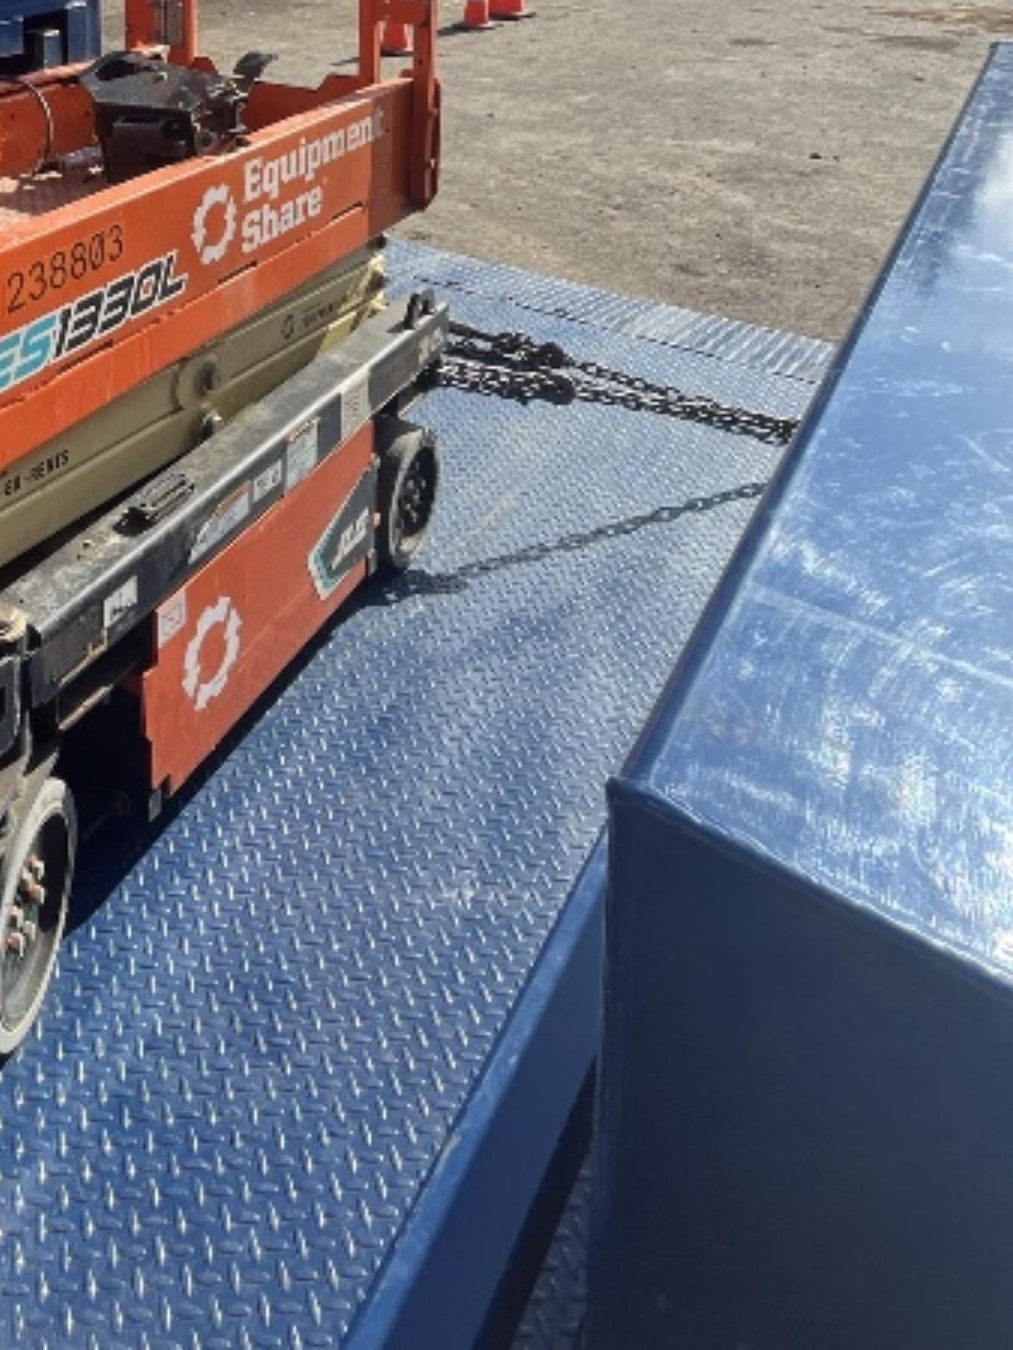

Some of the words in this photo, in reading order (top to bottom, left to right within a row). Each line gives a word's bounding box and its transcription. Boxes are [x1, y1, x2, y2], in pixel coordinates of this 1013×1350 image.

[243, 105, 385, 203] Equipment
[241, 186, 324, 253] Share
[6, 224, 125, 314] 238803
